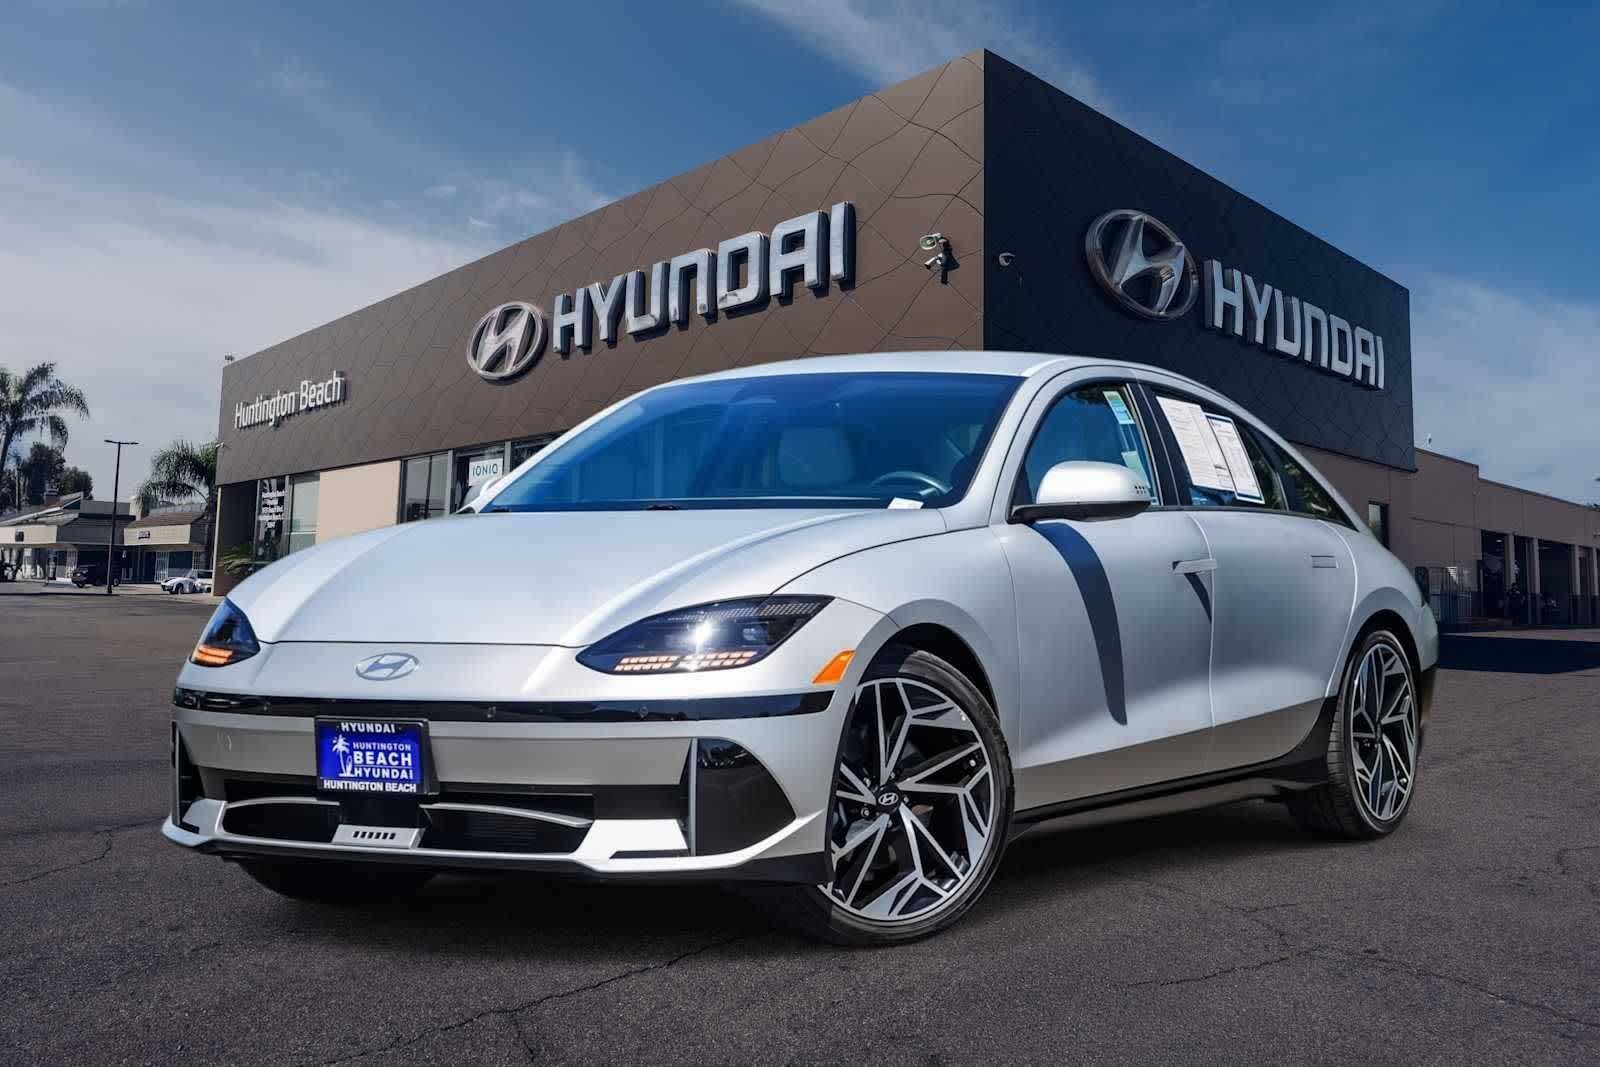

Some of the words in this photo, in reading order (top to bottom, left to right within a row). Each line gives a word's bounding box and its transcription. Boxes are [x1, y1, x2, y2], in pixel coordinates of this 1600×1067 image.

[552, 201, 854, 354] HYUNDAI
[1204, 258, 1386, 390] HYUNDAI
[234, 390, 297, 429] Huntington
[299, 370, 345, 411] Beach
[341, 722, 396, 733] HYUNDAI
[352, 742, 411, 751] HUNTINGTON
[353, 751, 412, 766] BEACH
[354, 767, 414, 779] HYUNDAI
[323, 780, 383, 792] HUNTINGTON
[385, 782, 417, 793] BEACH
